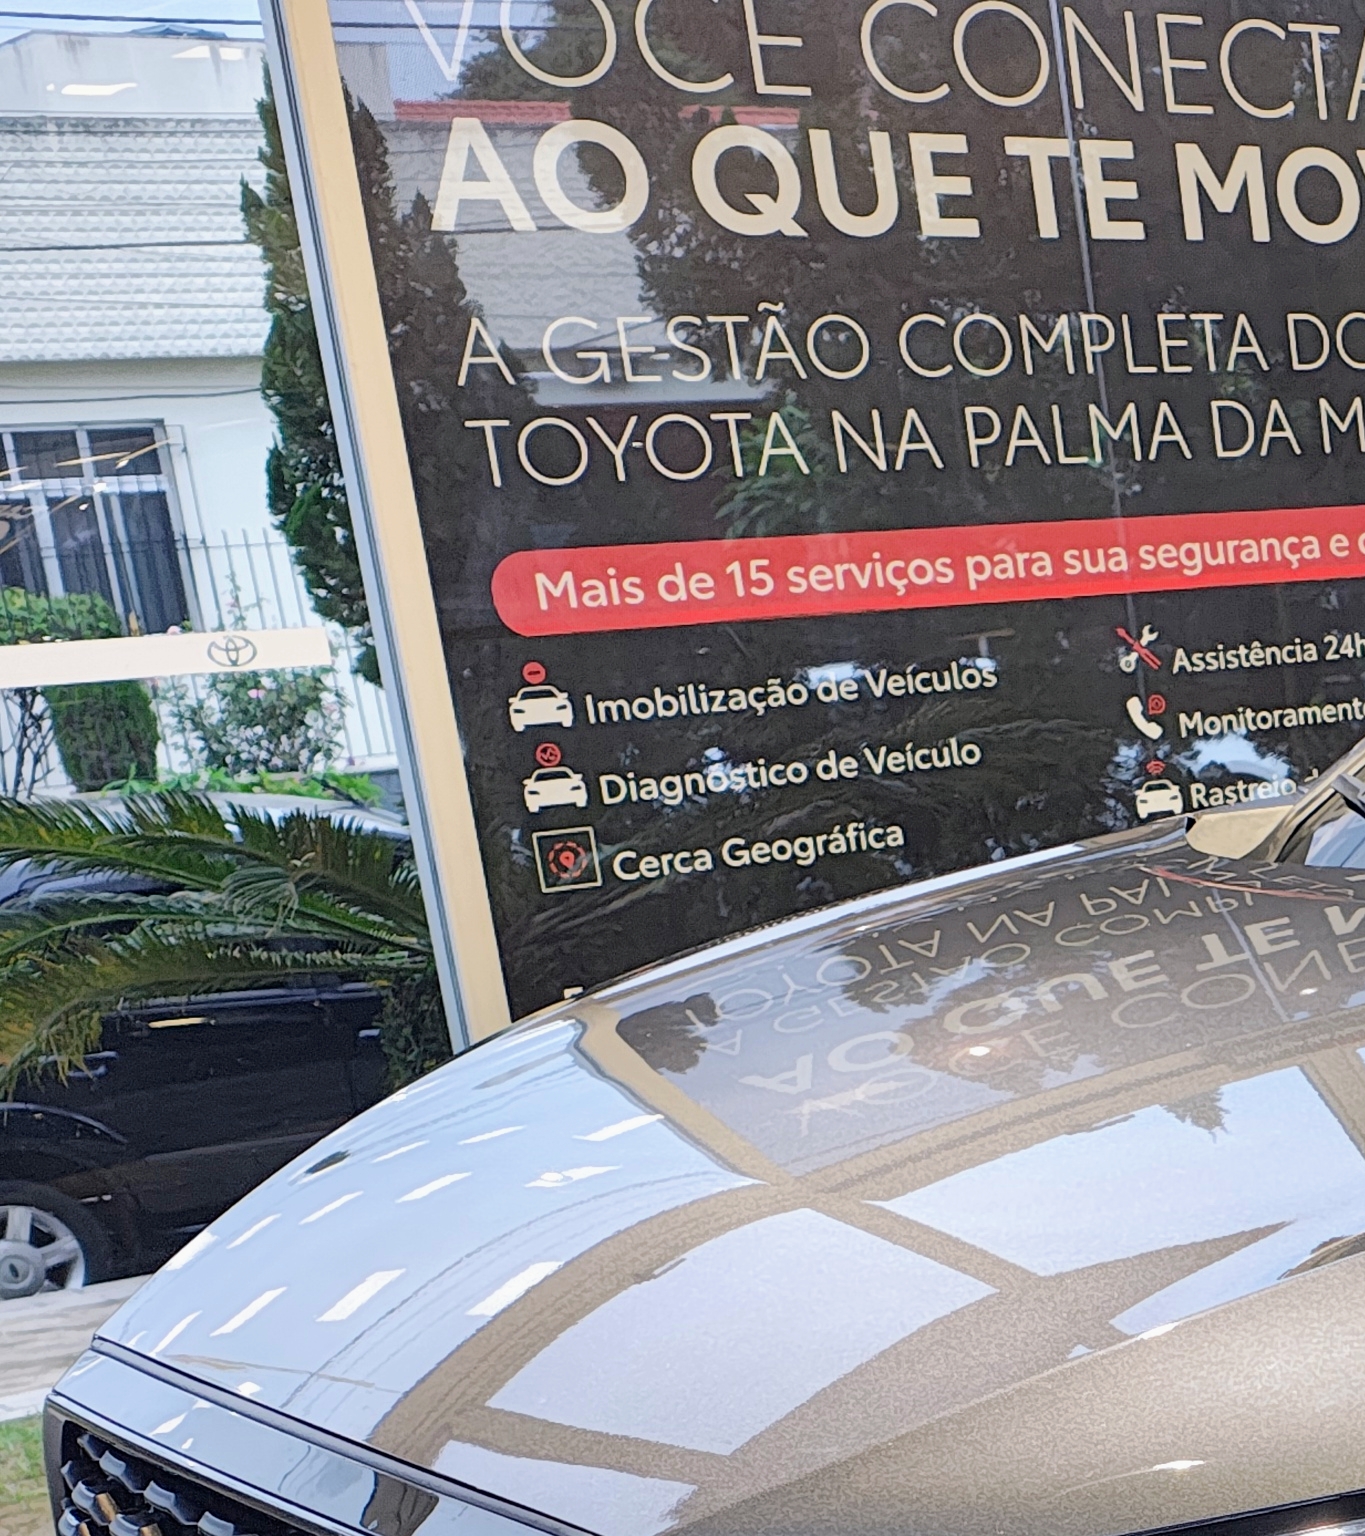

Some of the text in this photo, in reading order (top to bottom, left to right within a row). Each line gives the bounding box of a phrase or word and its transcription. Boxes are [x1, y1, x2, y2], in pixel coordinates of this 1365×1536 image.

[431, 116, 649, 234] AO
[692, 124, 981, 239] QUE
[1004, 136, 1147, 242] TE
[457, 316, 516, 387] A
[542, 302, 870, 384] GESTÃO
[899, 312, 1270, 379] COMPLETA
[466, 411, 810, 488] TOYOTA
[832, 408, 942, 473] NA
[964, 402, 1192, 468] PALMA
[1210, 398, 1301, 459] DA
[535, 568, 646, 611] Mais
[658, 562, 714, 602] de
[726, 558, 775, 597] 15
[787, 551, 955, 595] serviços
[966, 546, 1053, 591] para
[1064, 544, 1129, 574] sua
[1139, 533, 1322, 577] segurança
[1330, 532, 1350, 558] e
[1172, 638, 1319, 675] Assistência
[585, 661, 998, 725] Imobilização de Veículos
[600, 737, 982, 806] Diagnóstico de Veículo
[1190, 773, 1297, 809] Rastreio
[612, 822, 905, 881] Cerca Geográfica
